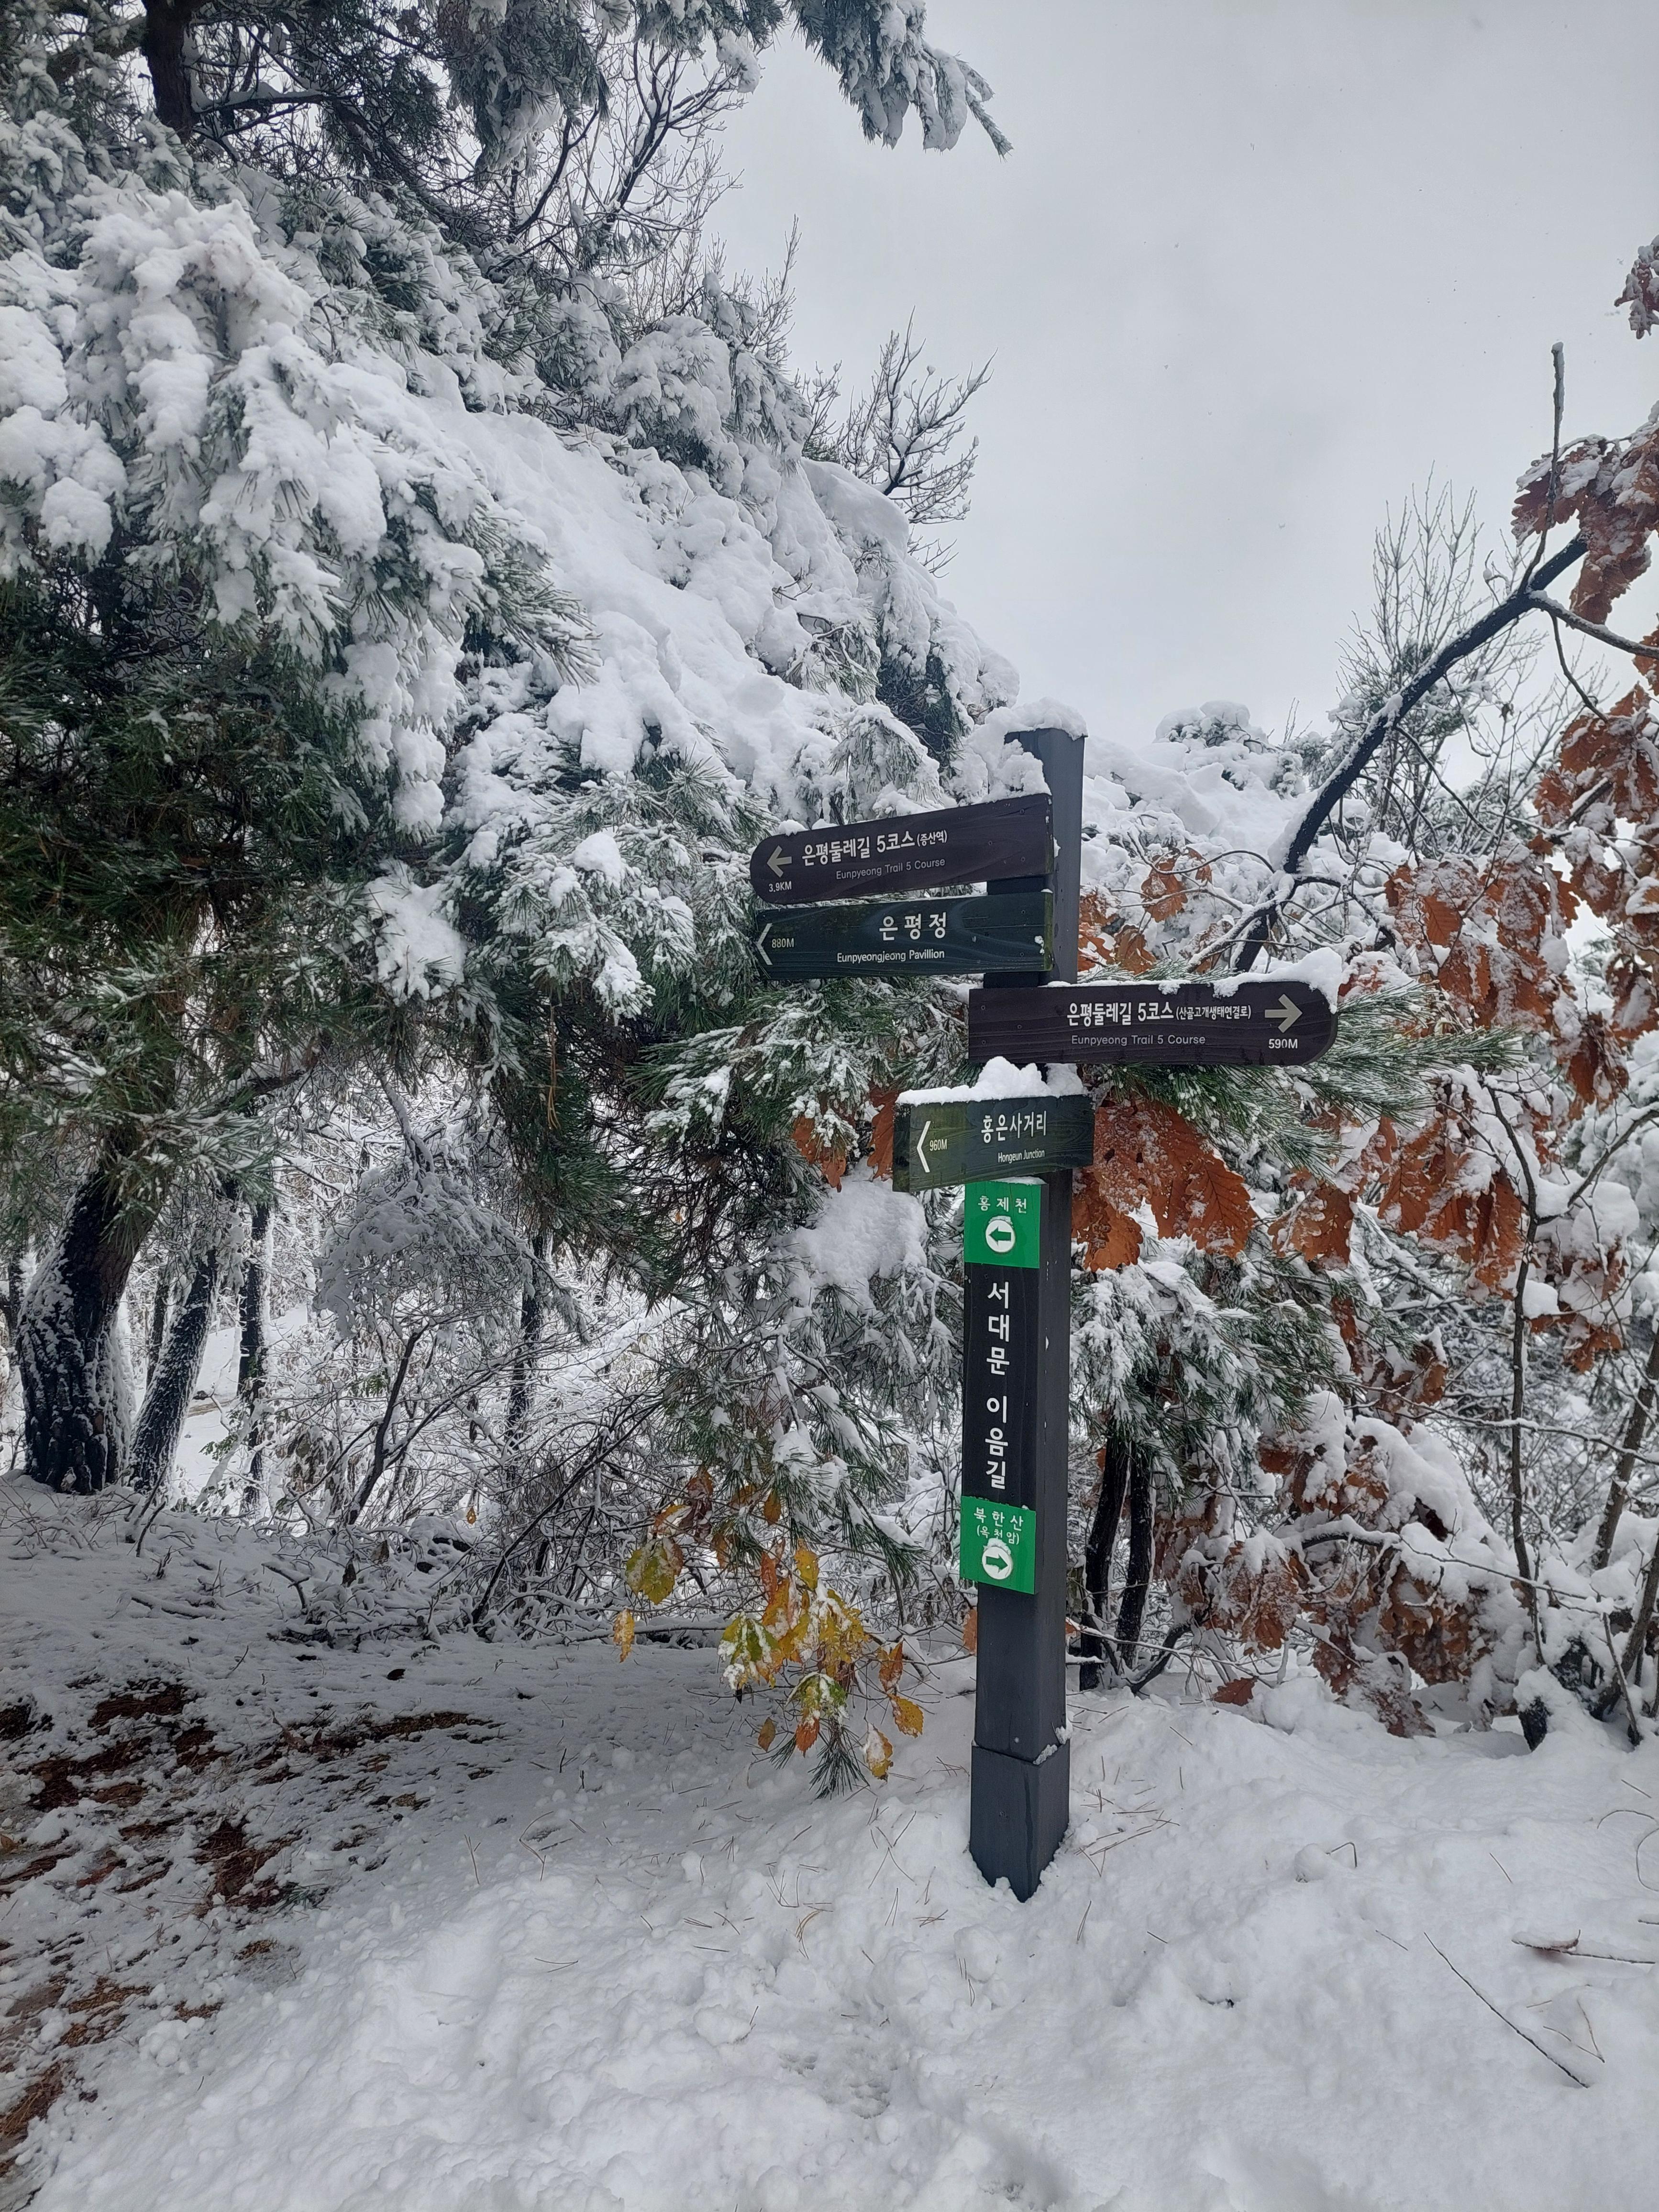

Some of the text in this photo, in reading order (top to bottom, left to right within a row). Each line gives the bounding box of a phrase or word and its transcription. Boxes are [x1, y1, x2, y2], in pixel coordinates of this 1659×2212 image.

[802, 836, 870, 866] 은평둘레길
[836, 859, 945, 880] Eunpyeong Trail 5 Course
[769, 881, 792, 892] 3.9KM
[772, 938, 795, 949] 880M
[837, 949, 945, 963] Eunpyeongjeong Pavillion
[1067, 1002, 1131, 1027] 은평둘레길
[1072, 1035, 1206, 1046] Eunpyeong Trail 5 Course
[1268, 1039, 1298, 1049] 590M
[981, 1110, 1047, 1144] 홍은사거리
[929, 1139, 947, 1151] 960M
[998, 1148, 1045, 1164] Hongeun Junction
